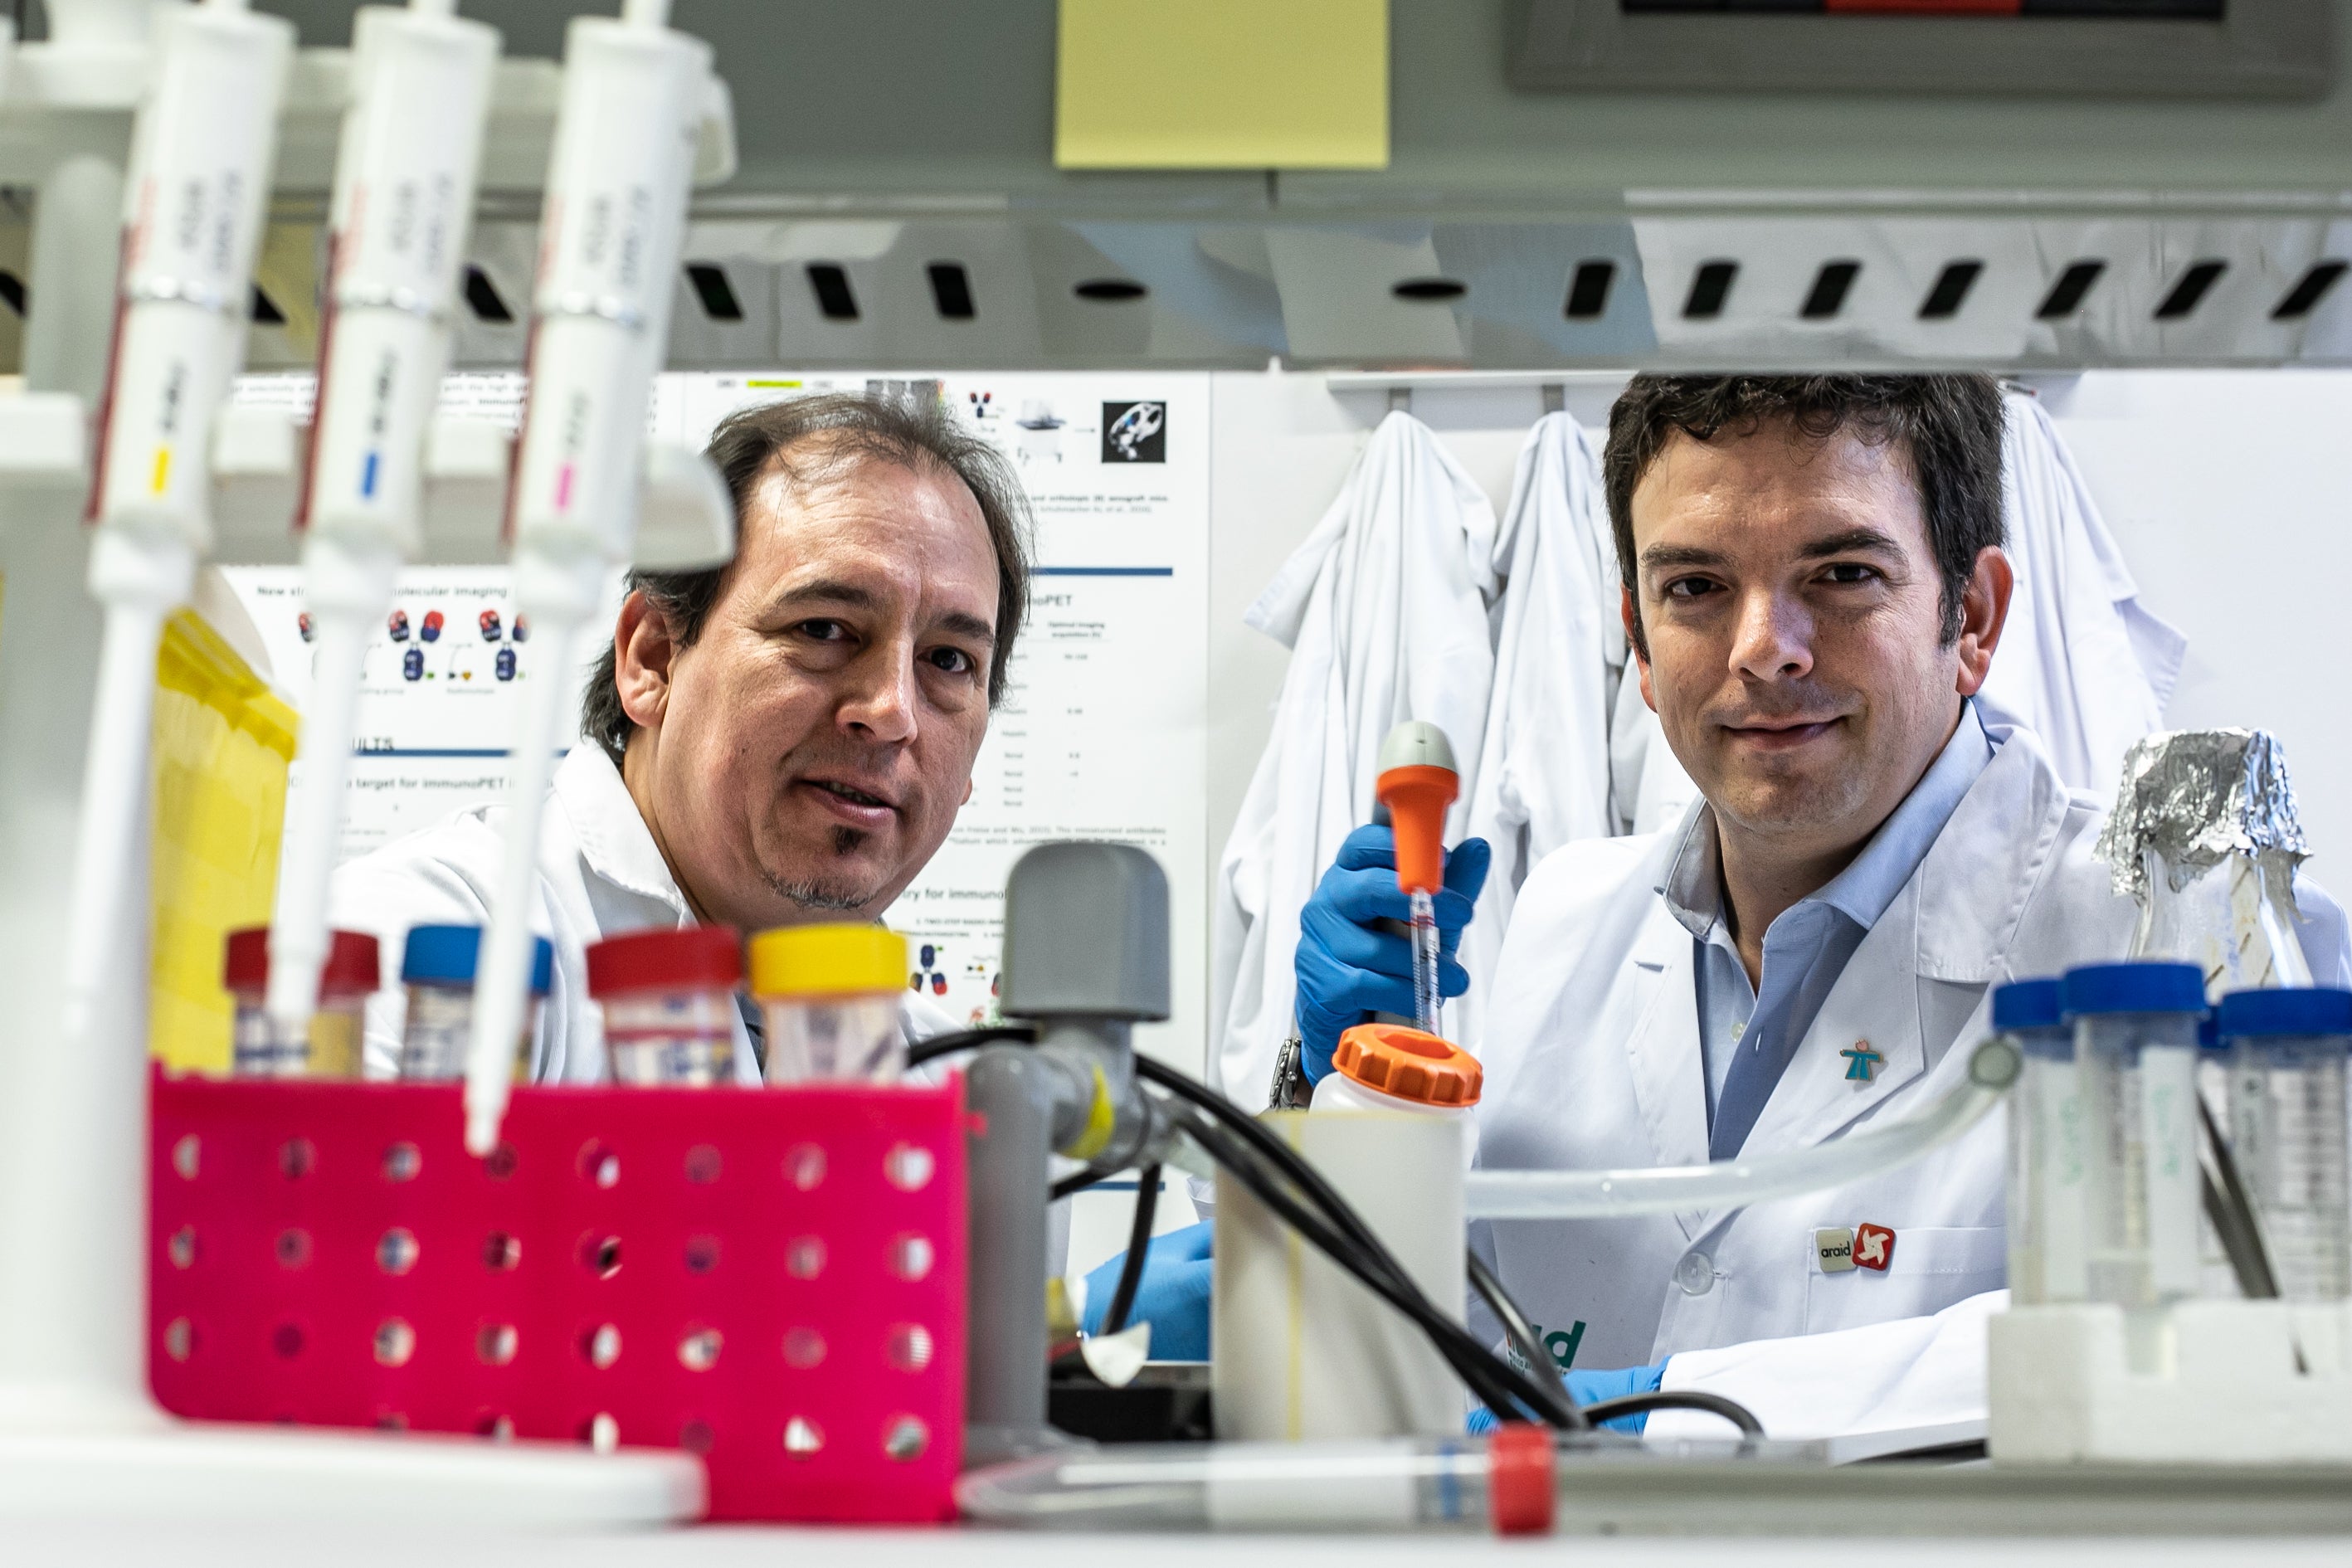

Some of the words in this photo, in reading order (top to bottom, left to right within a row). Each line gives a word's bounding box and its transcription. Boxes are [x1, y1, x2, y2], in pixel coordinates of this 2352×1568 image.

[454, 586, 508, 599] imaging
[400, 777, 417, 789] for
[1821, 1240, 1851, 1258] araid
